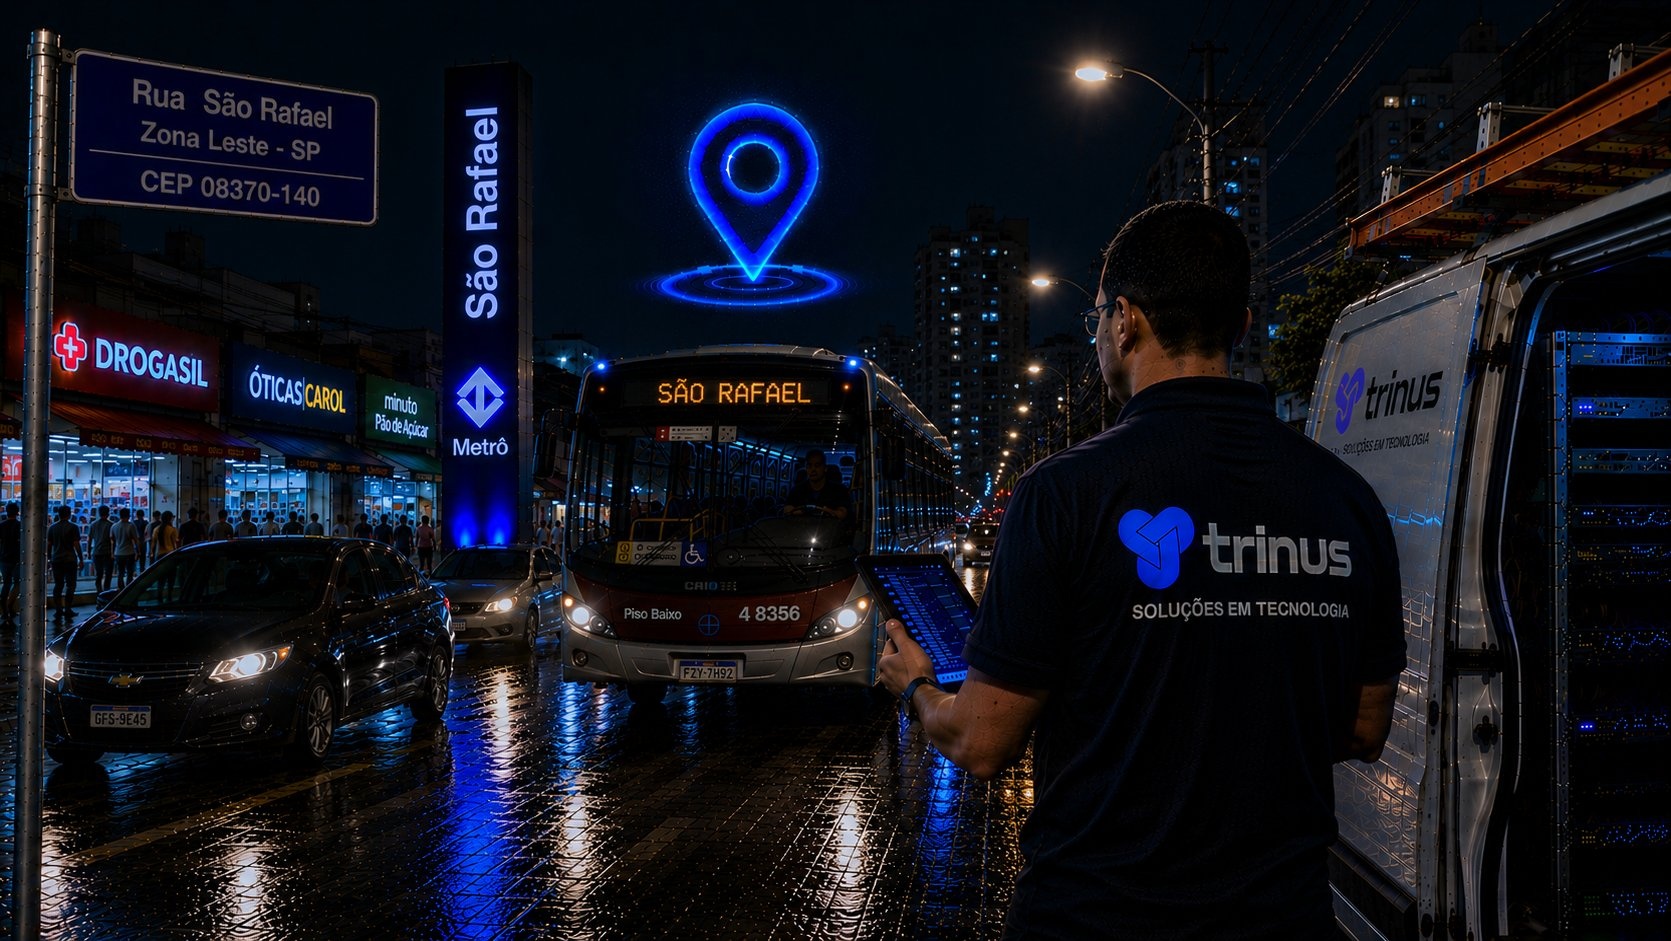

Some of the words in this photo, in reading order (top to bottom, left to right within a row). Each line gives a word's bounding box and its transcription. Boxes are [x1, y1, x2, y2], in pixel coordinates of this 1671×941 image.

[133, 78, 185, 111] Rua
[203, 88, 253, 120] São
[260, 97, 333, 130] Rafael
[140, 121, 200, 149] Zona
[209, 129, 269, 156] Leste
[291, 140, 320, 161] SP
[140, 169, 193, 195] CEP
[200, 175, 320, 208] 08370-140
[465, 107, 498, 231] Rafael
[465, 244, 498, 319] São
[95, 337, 209, 389] DROGASIL
[249, 364, 303, 406] ÓTICAS
[305, 383, 346, 414] CAROL
[384, 392, 418, 415] minuto
[658, 378, 705, 404] SÃO
[718, 382, 811, 404] RAFAEL
[1365, 369, 1444, 421] trinus
[375, 413, 391, 432] Pão
[392, 417, 402, 433] de
[402, 419, 429, 439] Açúcar
[453, 437, 509, 457] Metrô
[1202, 522, 1353, 578] trinus
[624, 607, 648, 620] Piso
[651, 608, 682, 621] Baixo
[755, 605, 800, 622] 8356
[1132, 597, 1224, 622] SOLUÇÕES
[1228, 601, 1251, 616] EM
[1255, 601, 1350, 619] TECNOLOGIA
[94, 712, 147, 726] GFS-9E45
